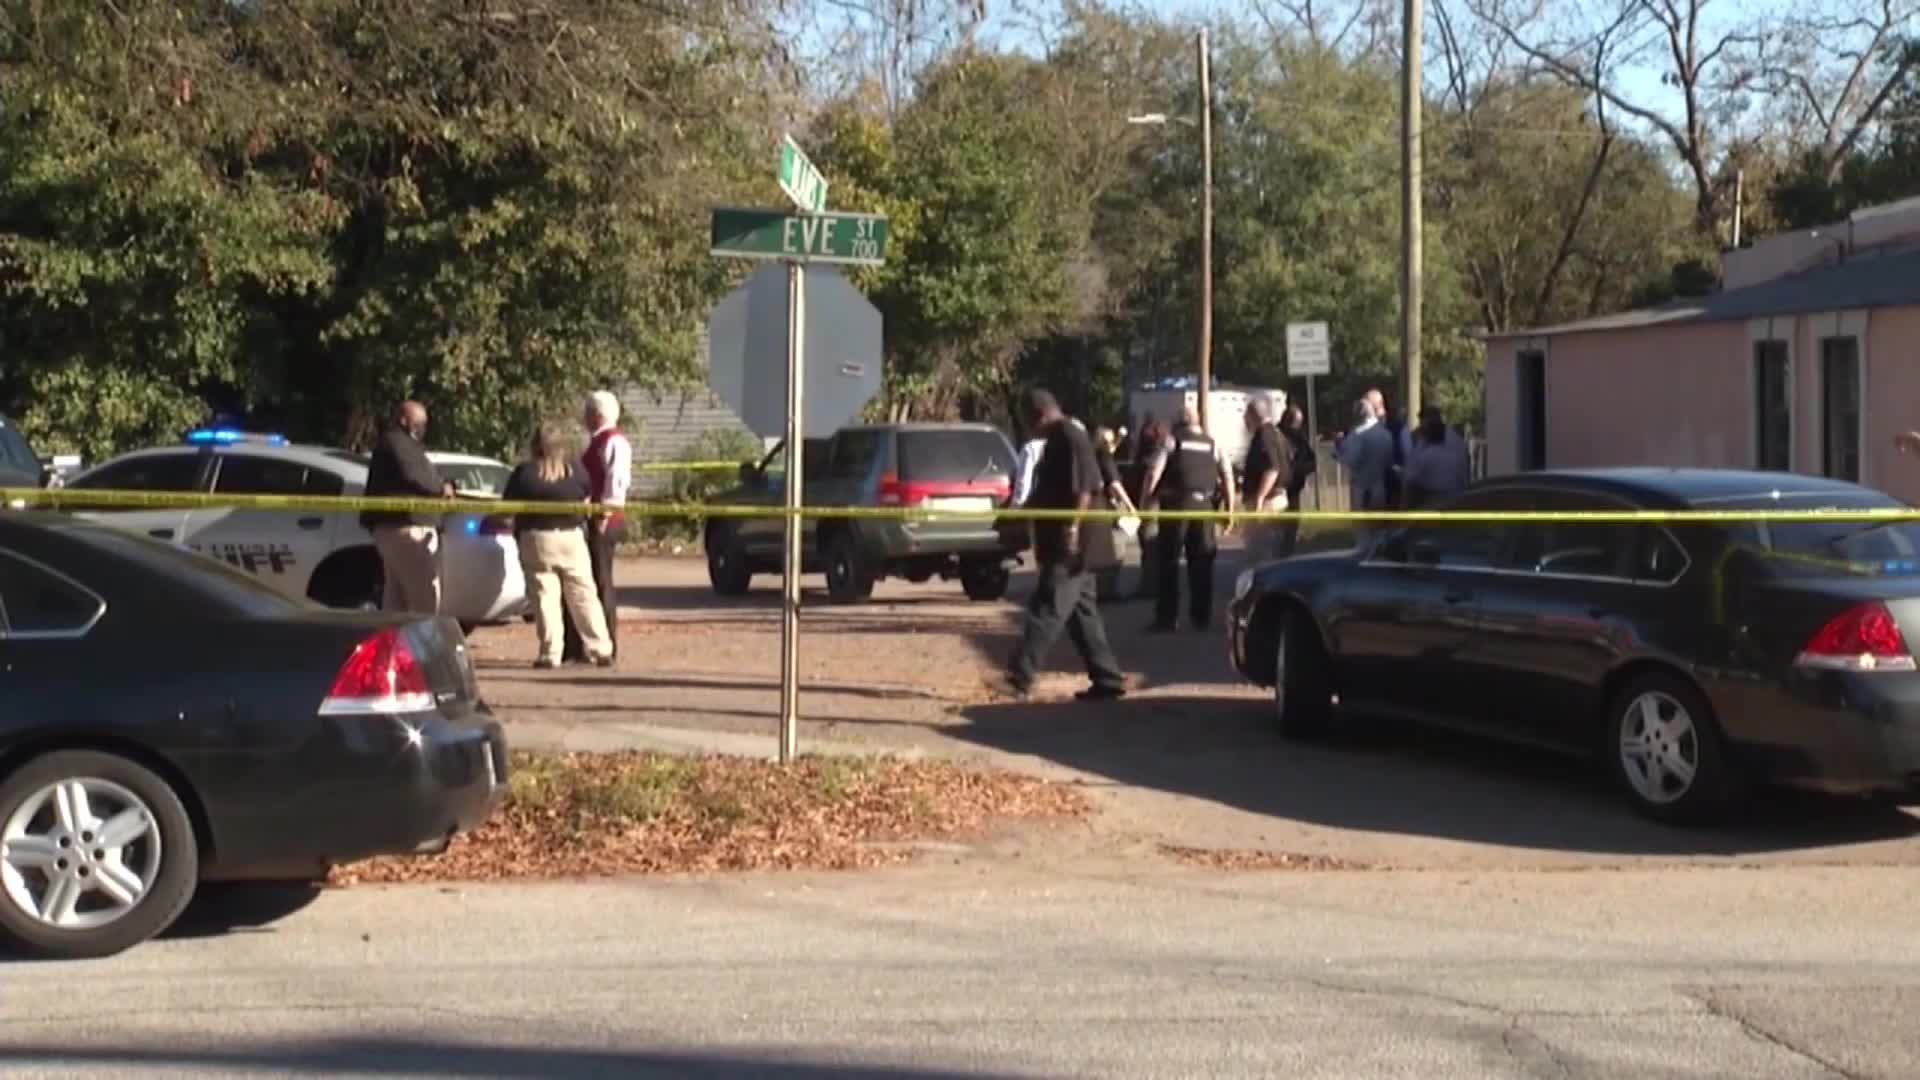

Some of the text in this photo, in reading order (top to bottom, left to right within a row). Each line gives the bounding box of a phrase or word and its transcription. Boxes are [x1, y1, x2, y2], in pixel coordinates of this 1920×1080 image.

[784, 217, 875, 254] EVE ST
[851, 239, 878, 258] 700
